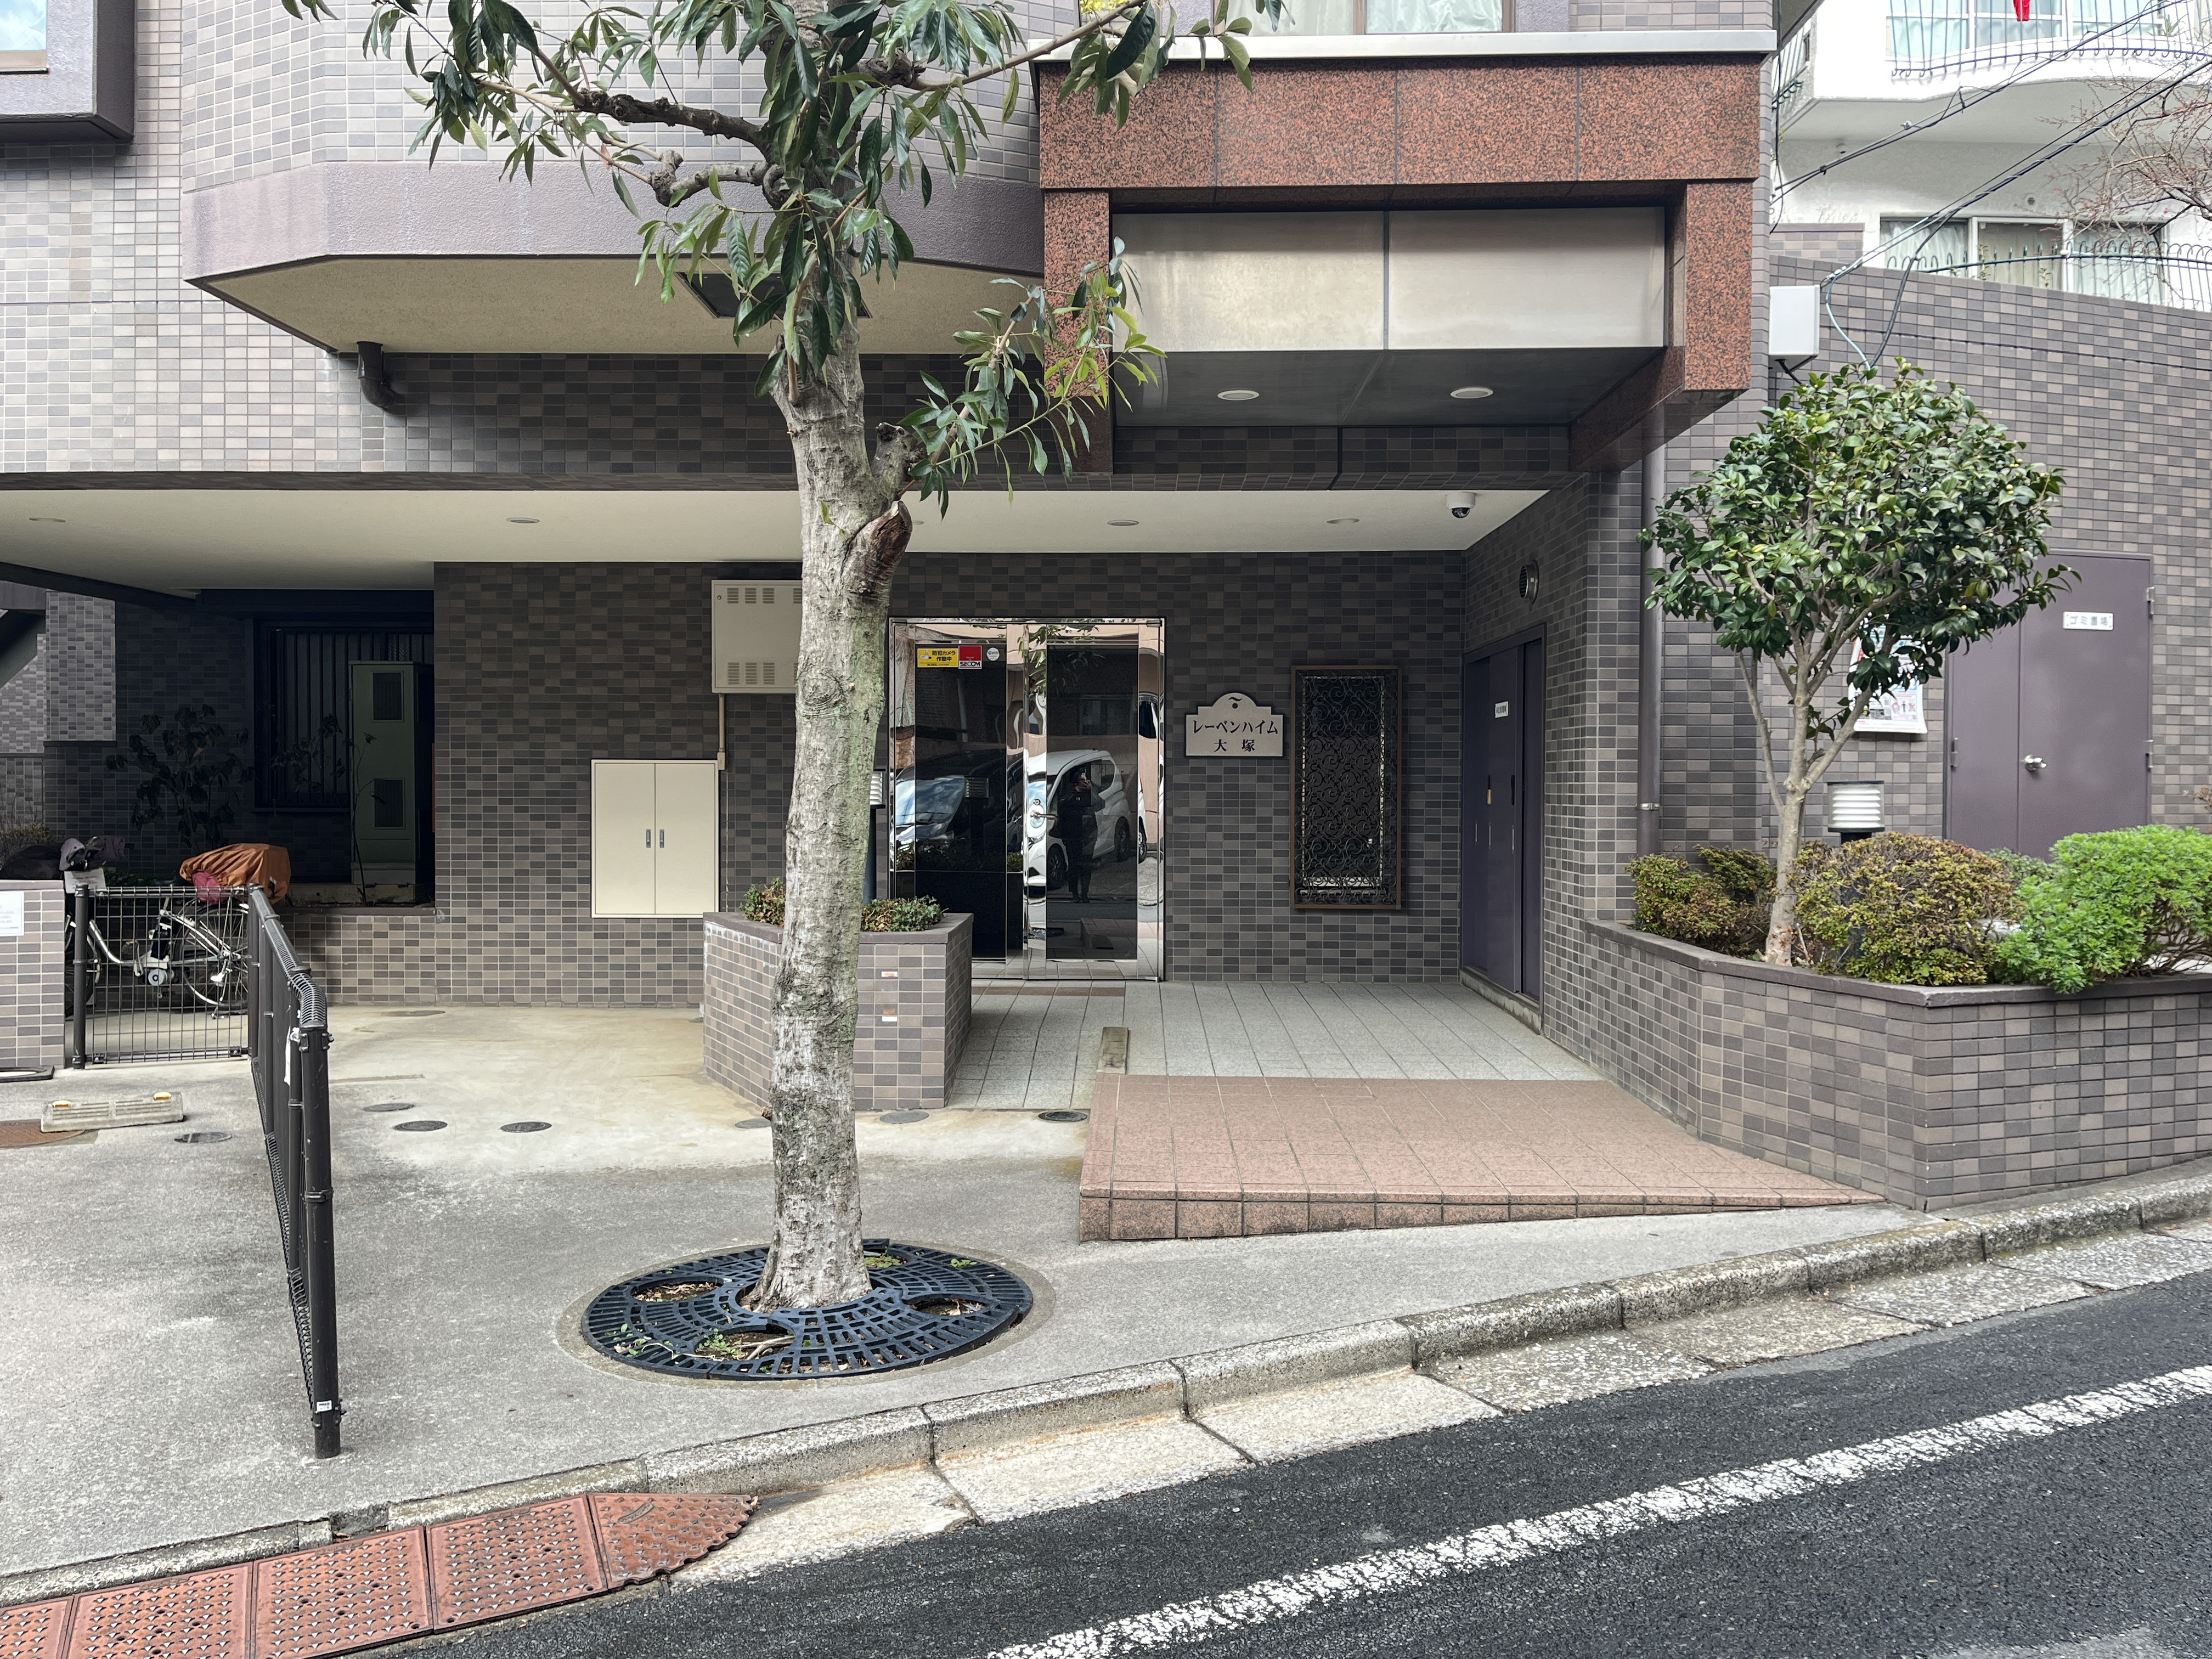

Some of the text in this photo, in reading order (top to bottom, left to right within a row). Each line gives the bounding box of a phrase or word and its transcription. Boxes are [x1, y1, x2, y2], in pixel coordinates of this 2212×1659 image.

[1193, 720, 1278, 735] レーベンハイム
